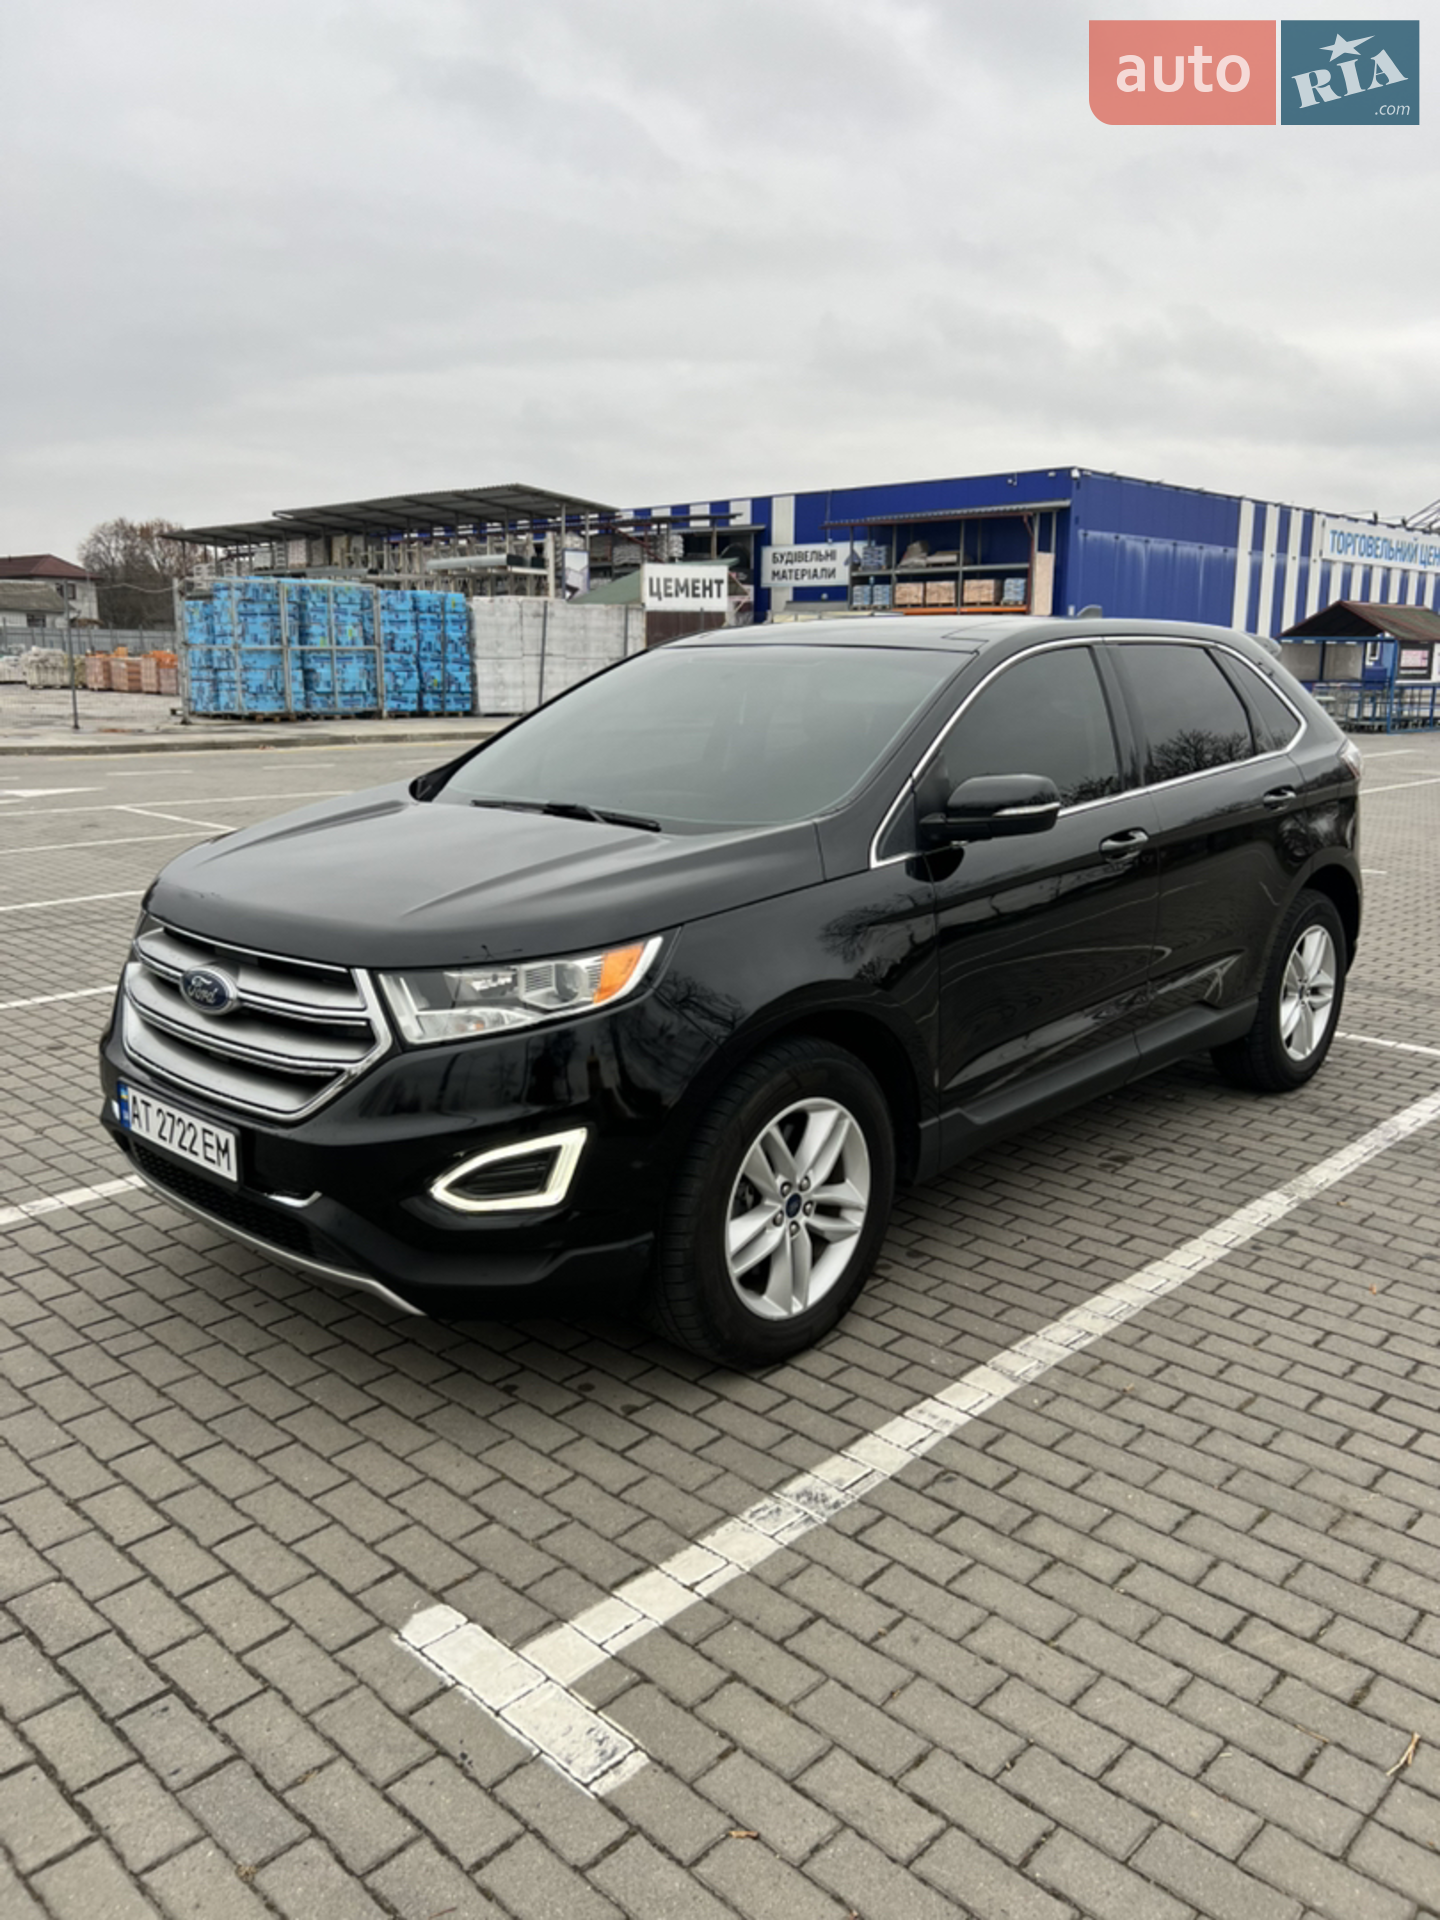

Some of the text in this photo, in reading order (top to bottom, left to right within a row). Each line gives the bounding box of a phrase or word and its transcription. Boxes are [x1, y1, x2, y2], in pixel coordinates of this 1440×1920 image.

[771, 549, 837, 566] БУДІВЕЛЬНІ
[1330, 529, 1418, 564] ТОРГОВЕЛЬНИЙ
[771, 567, 837, 581] МАТЕРІАЛИ
[648, 577, 724, 601] ЦЕМЕНТ
[187, 975, 219, 1005] Ford
[131, 1094, 232, 1172] AT 2722 EM
